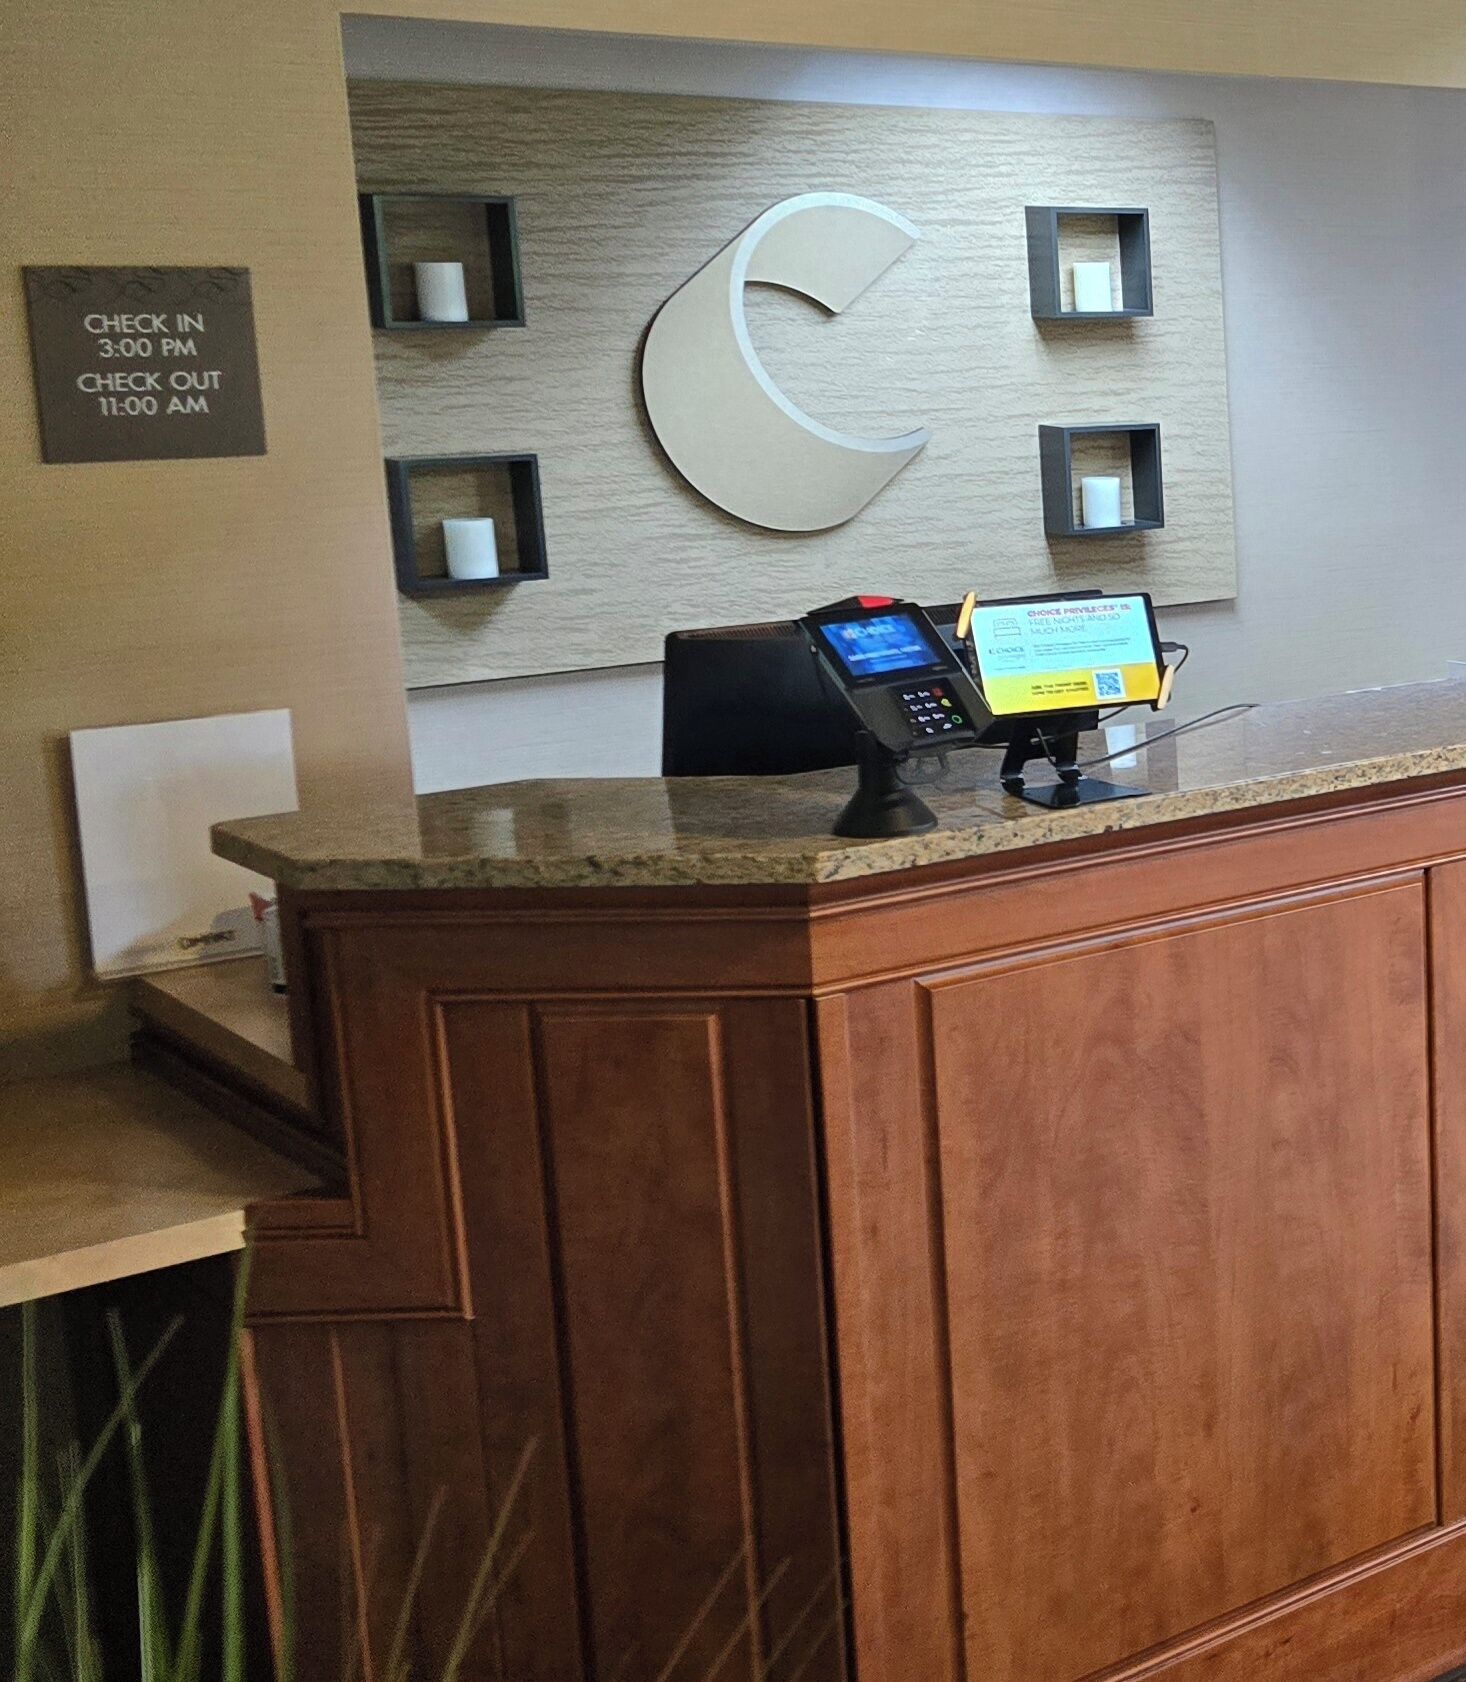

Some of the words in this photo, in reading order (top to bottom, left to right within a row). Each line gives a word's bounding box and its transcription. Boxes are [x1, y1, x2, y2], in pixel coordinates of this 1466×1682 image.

[83, 314, 169, 334] CHECK
[176, 313, 205, 332] IN
[98, 338, 152, 358] 3:00
[161, 338, 197, 357] PM
[77, 372, 162, 393] CHECK
[169, 370, 222, 391] OUT
[98, 396, 158, 416] 11:00
[166, 395, 209, 415] AM
[1027, 607, 1062, 617] CHOICE
[1029, 616, 1051, 627] FREE
